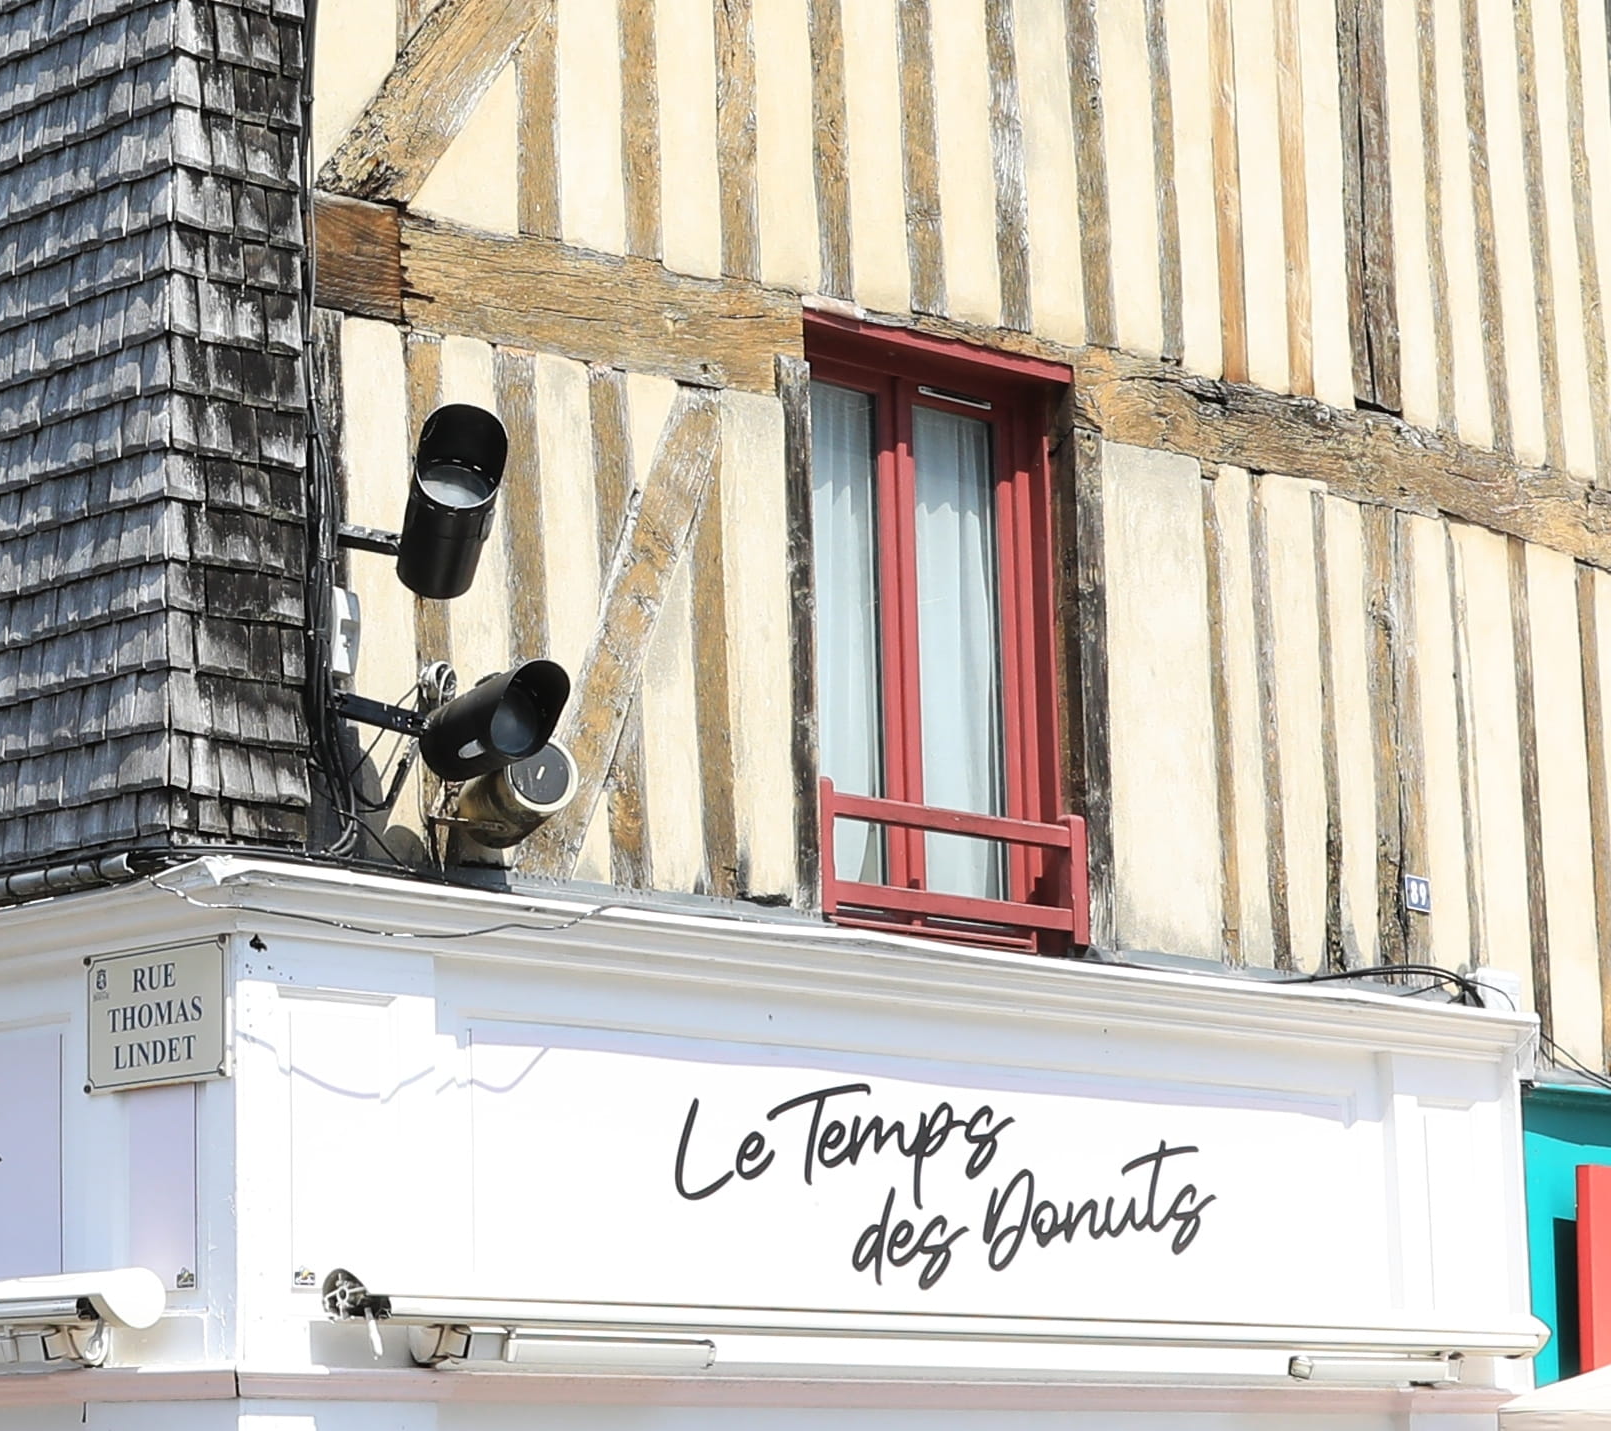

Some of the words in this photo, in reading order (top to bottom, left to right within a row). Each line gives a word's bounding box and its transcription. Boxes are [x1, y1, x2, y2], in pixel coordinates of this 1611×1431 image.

[133, 962, 176, 993] RUE
[107, 995, 203, 1033] THOMAS
[114, 1034, 196, 1070] LINDET
[674, 1097, 777, 1201] Le
[766, 1083, 1015, 1209] Temps
[852, 1187, 969, 1290] des
[982, 1140, 1217, 1273] Donuts
